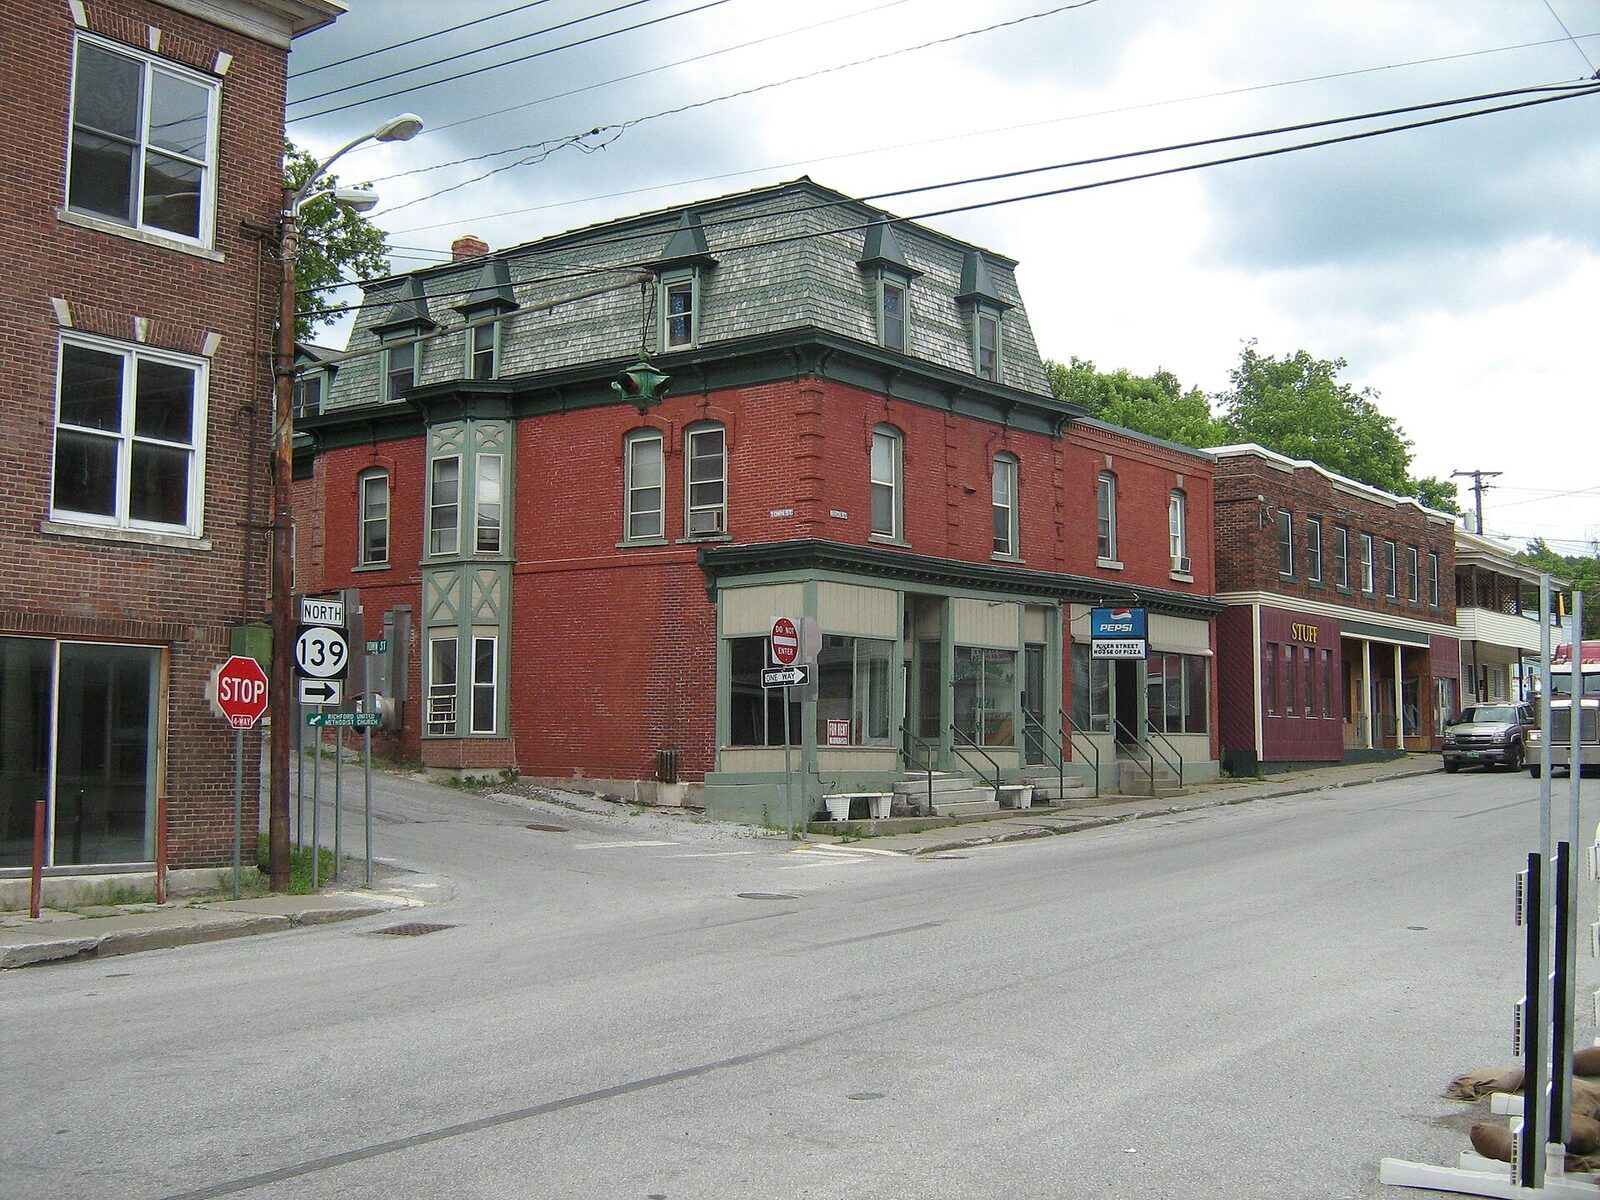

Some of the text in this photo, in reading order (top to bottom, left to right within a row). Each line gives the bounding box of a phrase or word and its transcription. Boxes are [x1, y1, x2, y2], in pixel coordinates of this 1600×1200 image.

[304, 604, 342, 621] NORTH
[775, 625, 795, 635] DO NOT
[1100, 623, 1133, 632] PEPSI
[1291, 622, 1318, 643] STUFF
[380, 640, 387, 651] ST
[778, 646, 794, 656] ENTER
[300, 638, 344, 666] 139
[765, 672, 795, 682] ONE WAY
[220, 676, 265, 704] STOP
[233, 717, 251, 727] 4-WAY
[829, 722, 848, 737] FOR RENT
